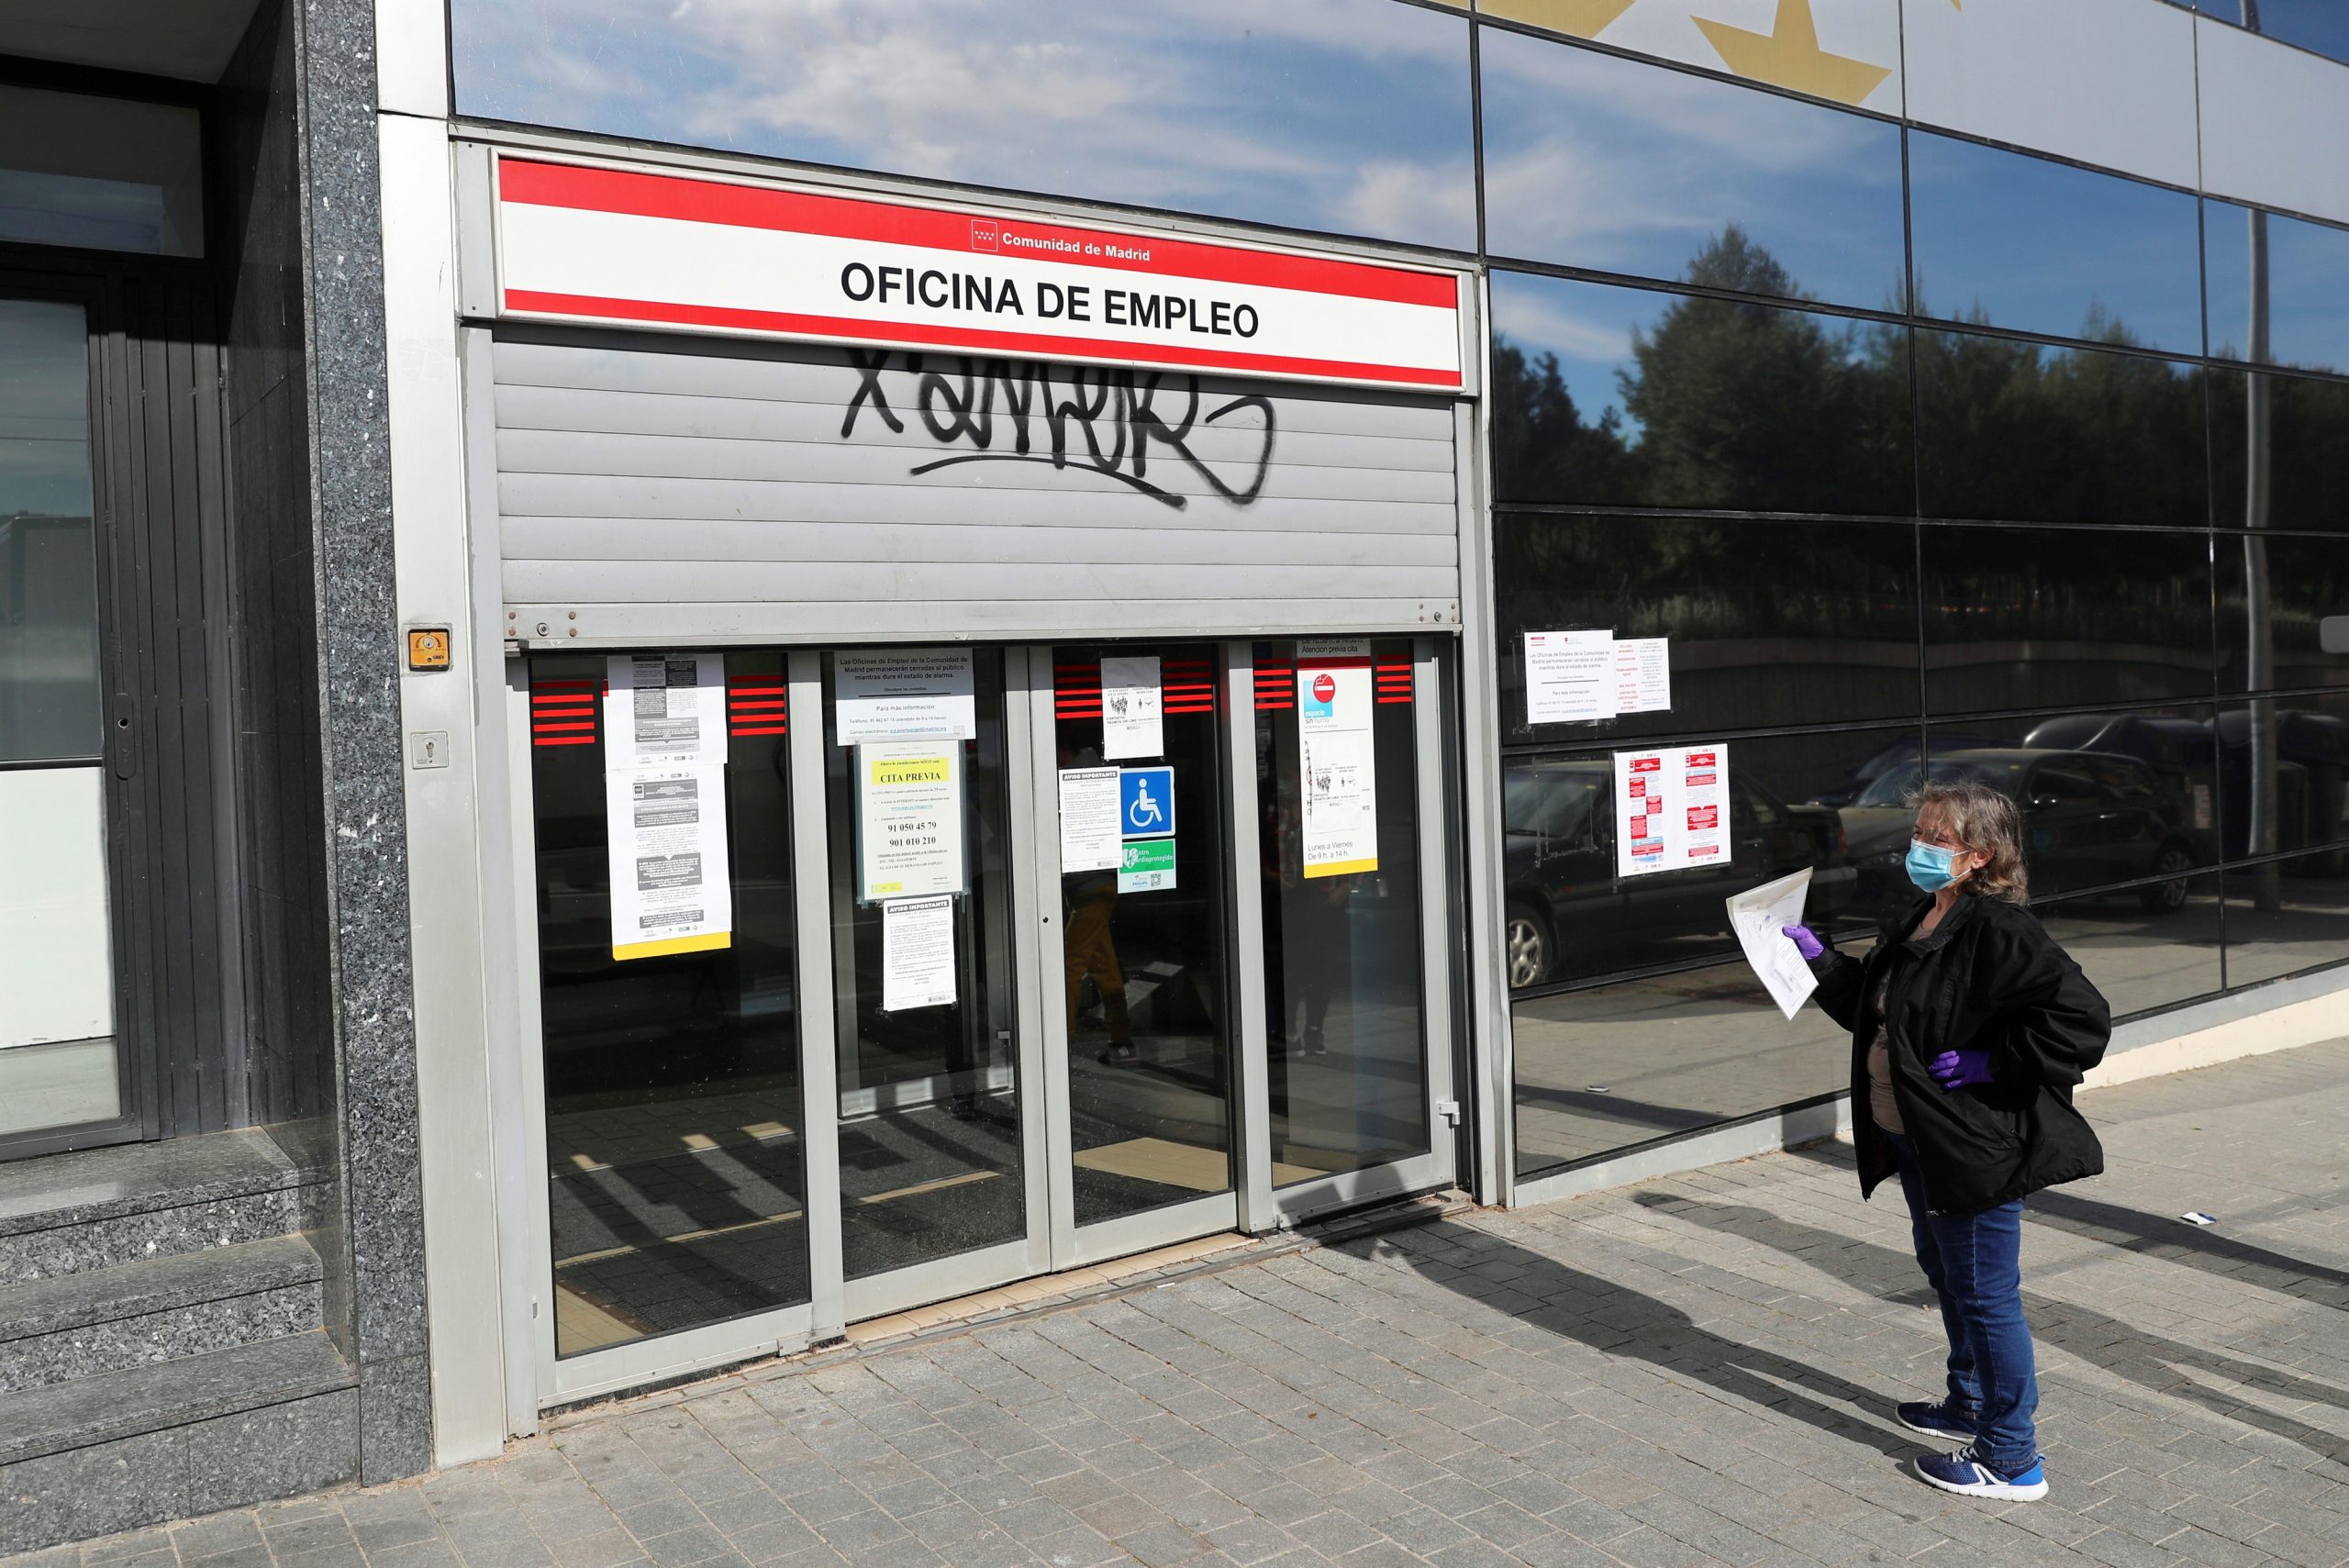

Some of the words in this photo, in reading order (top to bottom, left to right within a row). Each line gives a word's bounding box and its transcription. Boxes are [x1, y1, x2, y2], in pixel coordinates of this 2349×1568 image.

[1002, 232, 1081, 254] Comunidad
[1085, 242, 1101, 257] de
[1106, 245, 1151, 261] Madrid
[841, 262, 1024, 316] OFICINA
[1038, 282, 1091, 322] DE
[1105, 290, 1259, 338] EMPLEO
[881, 774, 903, 784] CITA
[906, 773, 941, 782] PREVIA
[888, 825, 897, 833] 91
[899, 823, 914, 832] 050
[916, 822, 926, 830] 45
[906, 838, 920, 846] 010
[922, 837, 936, 845] 210
[1308, 844, 1326, 852] Lunes
[909, 900, 949, 911] IMPORTANTE
